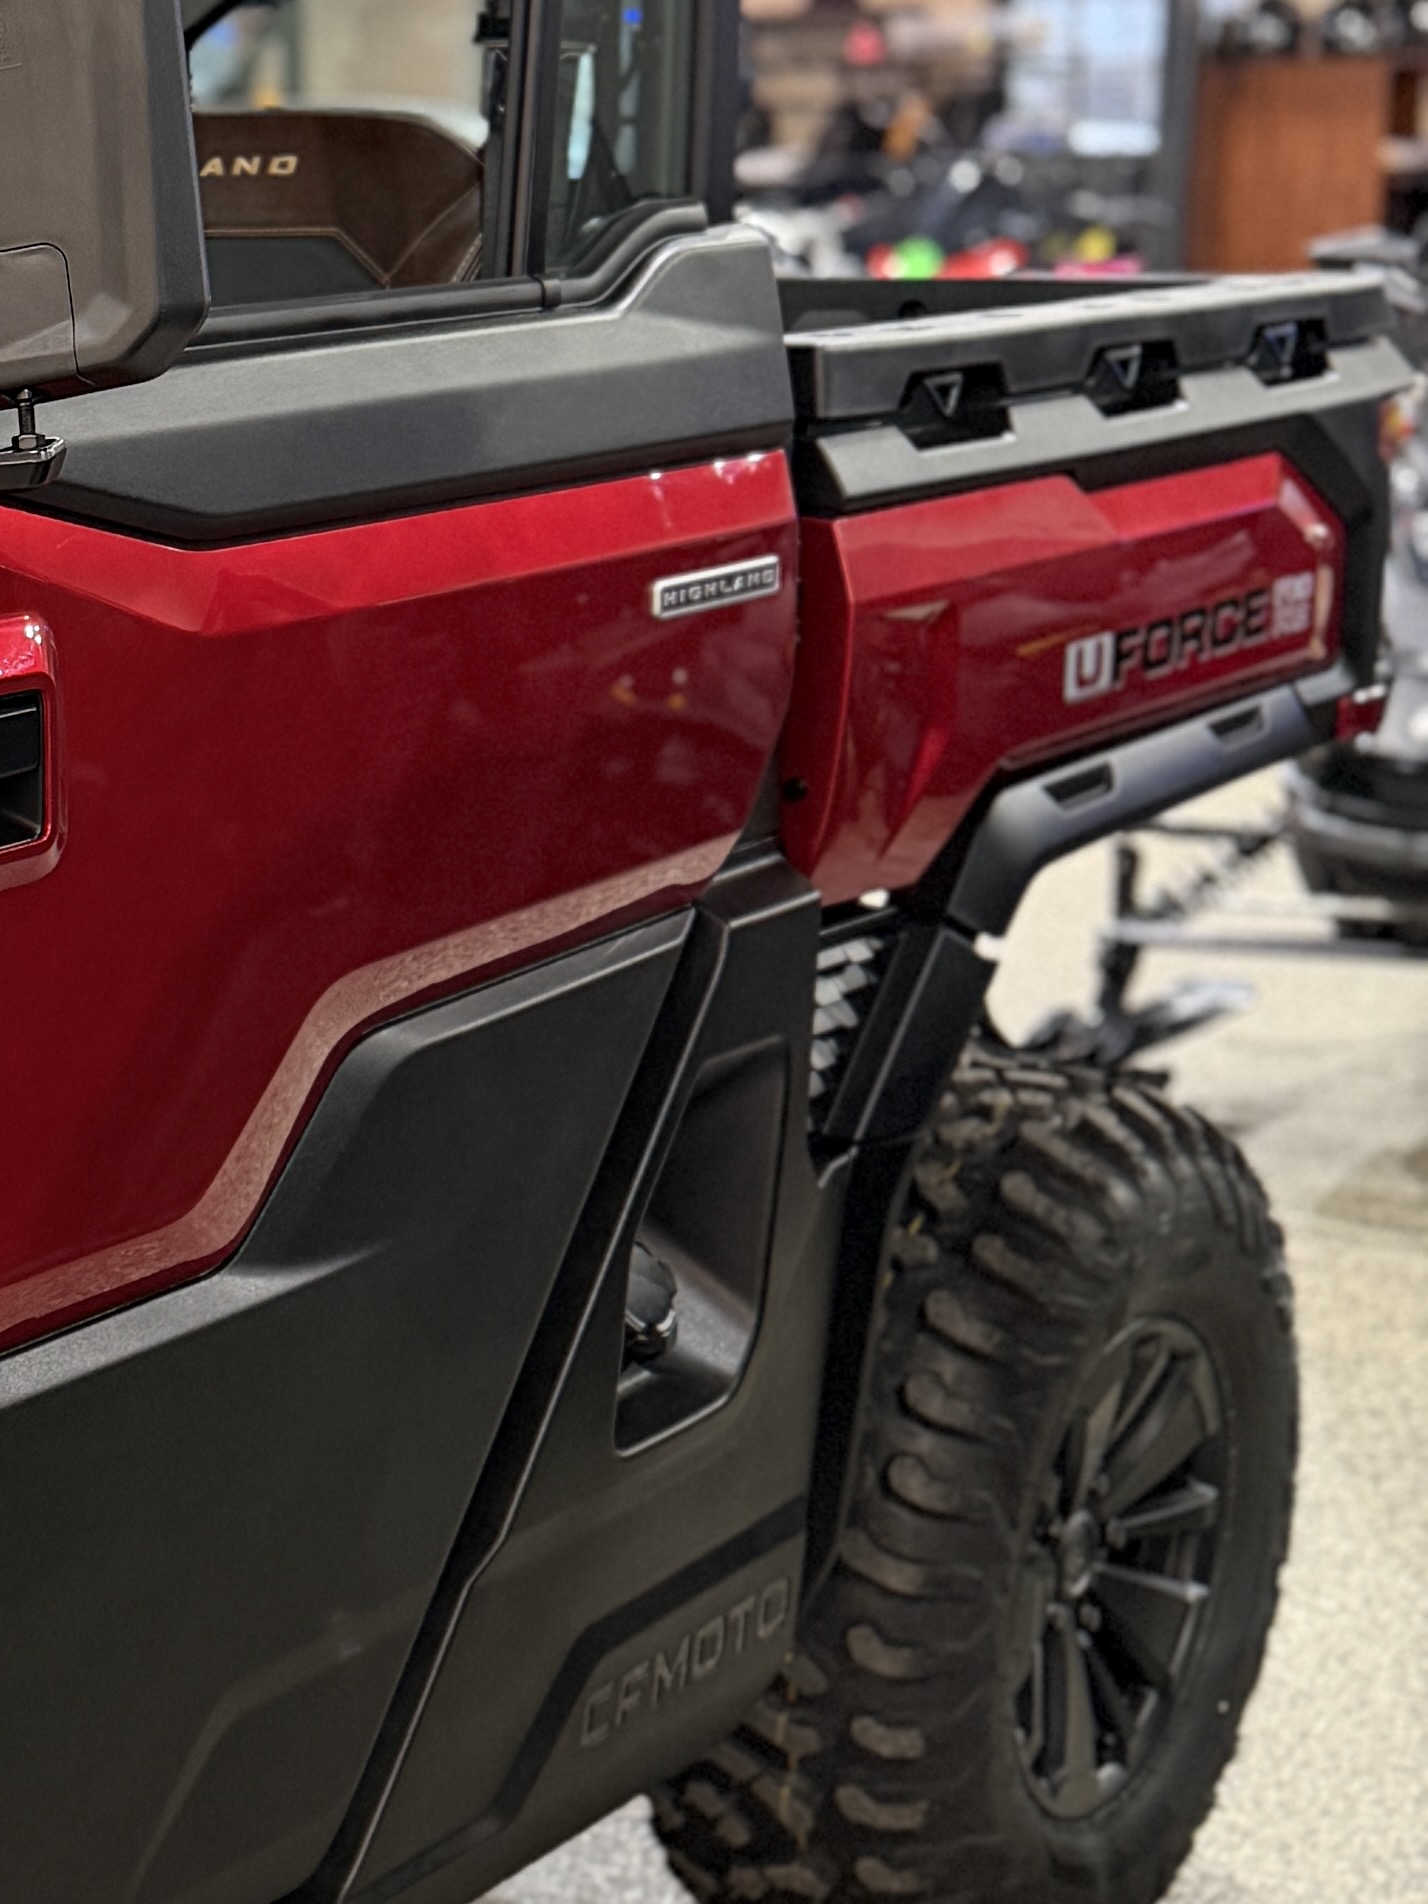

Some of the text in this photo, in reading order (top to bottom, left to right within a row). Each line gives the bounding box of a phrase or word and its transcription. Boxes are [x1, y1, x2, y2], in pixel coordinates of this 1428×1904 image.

[198, 154, 299, 177] AND
[663, 569, 775, 608] HIGHLAND
[578, 1577, 791, 1749] CFMOTO
